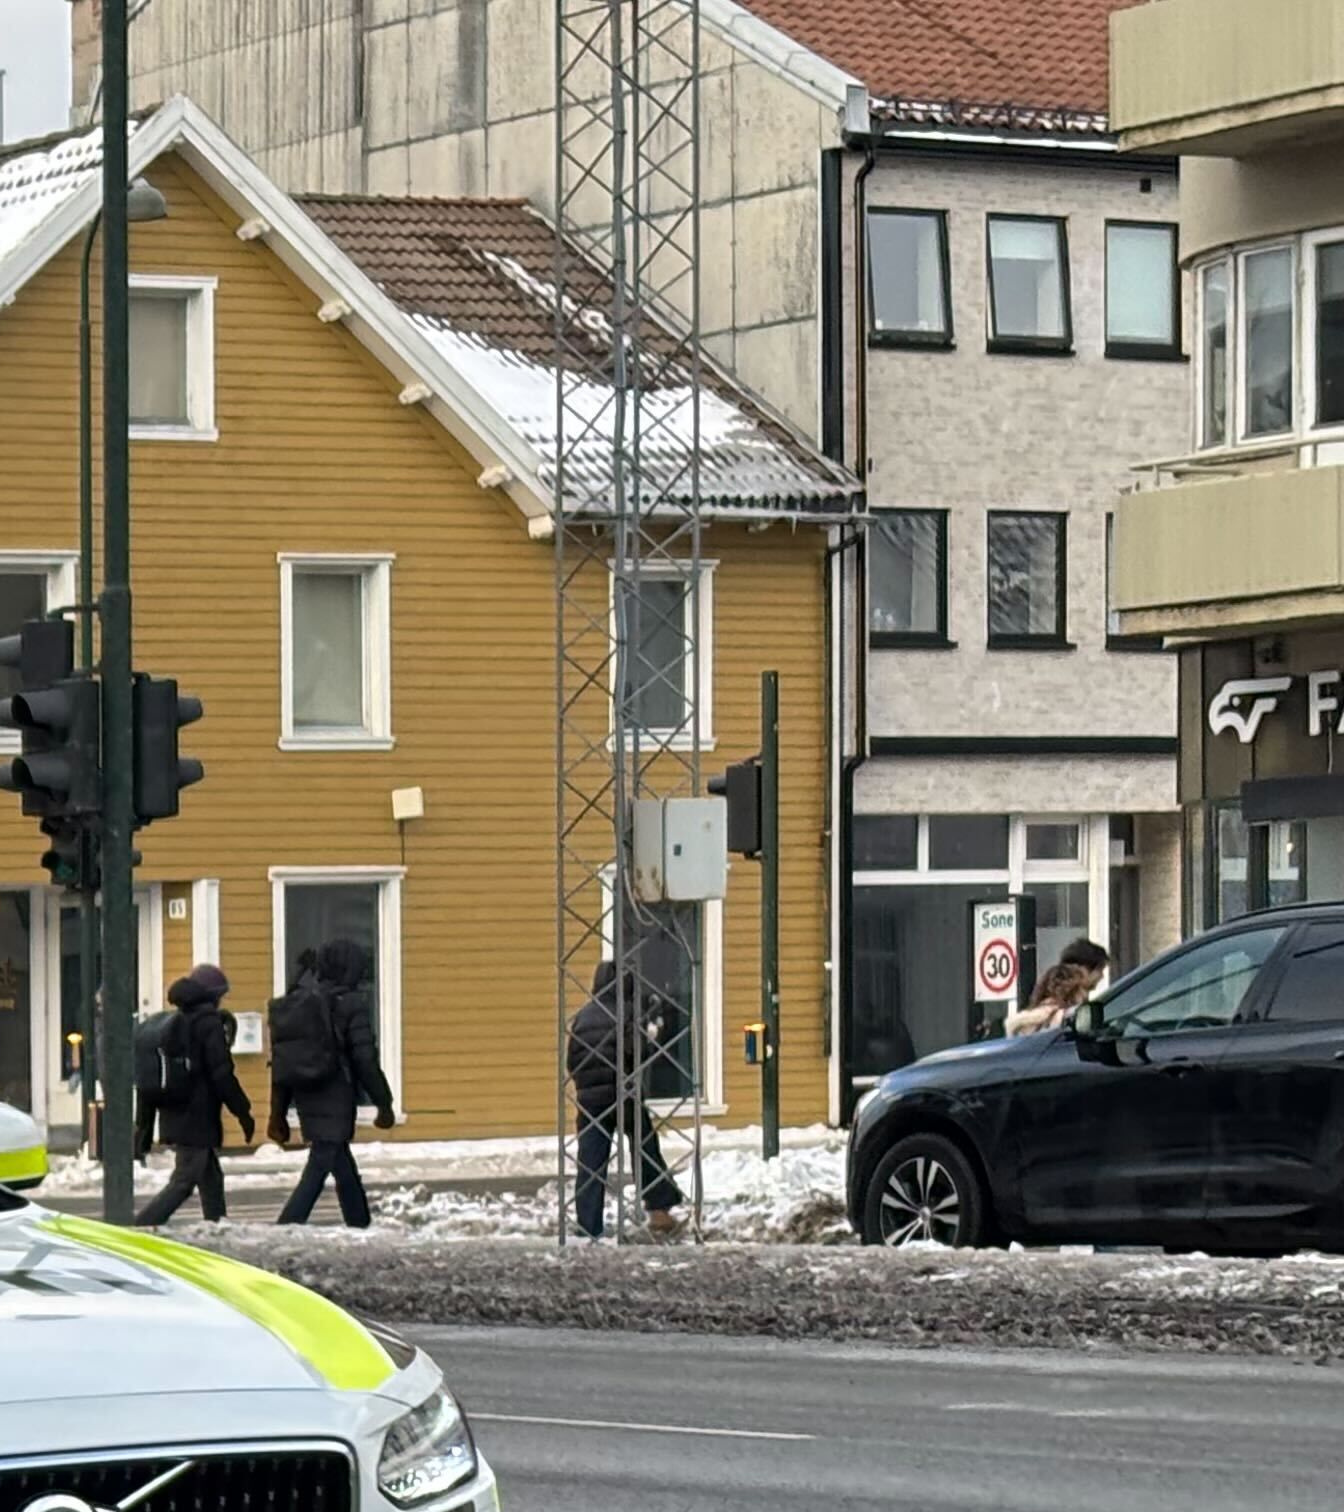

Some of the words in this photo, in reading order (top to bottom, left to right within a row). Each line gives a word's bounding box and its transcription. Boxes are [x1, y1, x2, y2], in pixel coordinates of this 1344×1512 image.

[1308, 669, 1344, 737] F
[982, 911, 1014, 929] Sone
[987, 953, 1010, 979] 30
